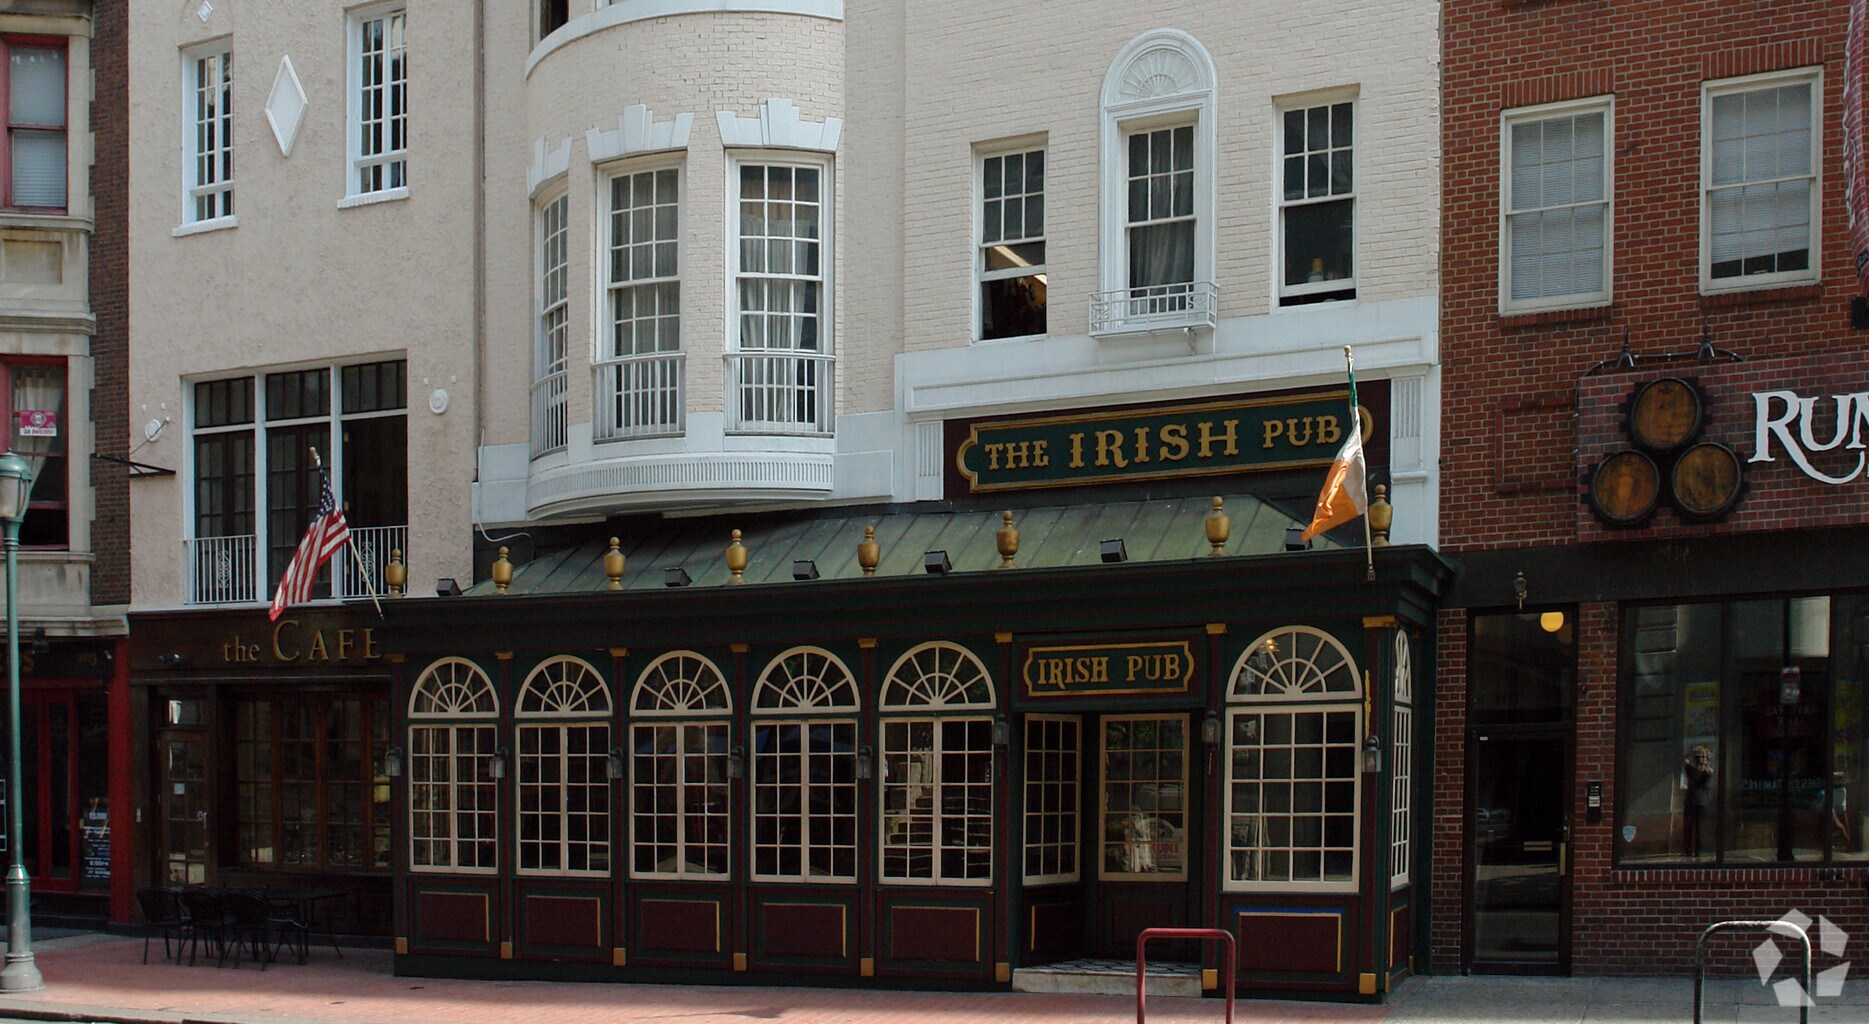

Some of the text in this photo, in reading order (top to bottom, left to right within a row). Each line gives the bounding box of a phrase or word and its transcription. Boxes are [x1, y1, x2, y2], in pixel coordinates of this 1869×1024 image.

[984, 415, 1342, 470] THE IRISH PUB
[223, 619, 382, 662] the CAFE
[1037, 653, 1181, 690] IRISH PUB
